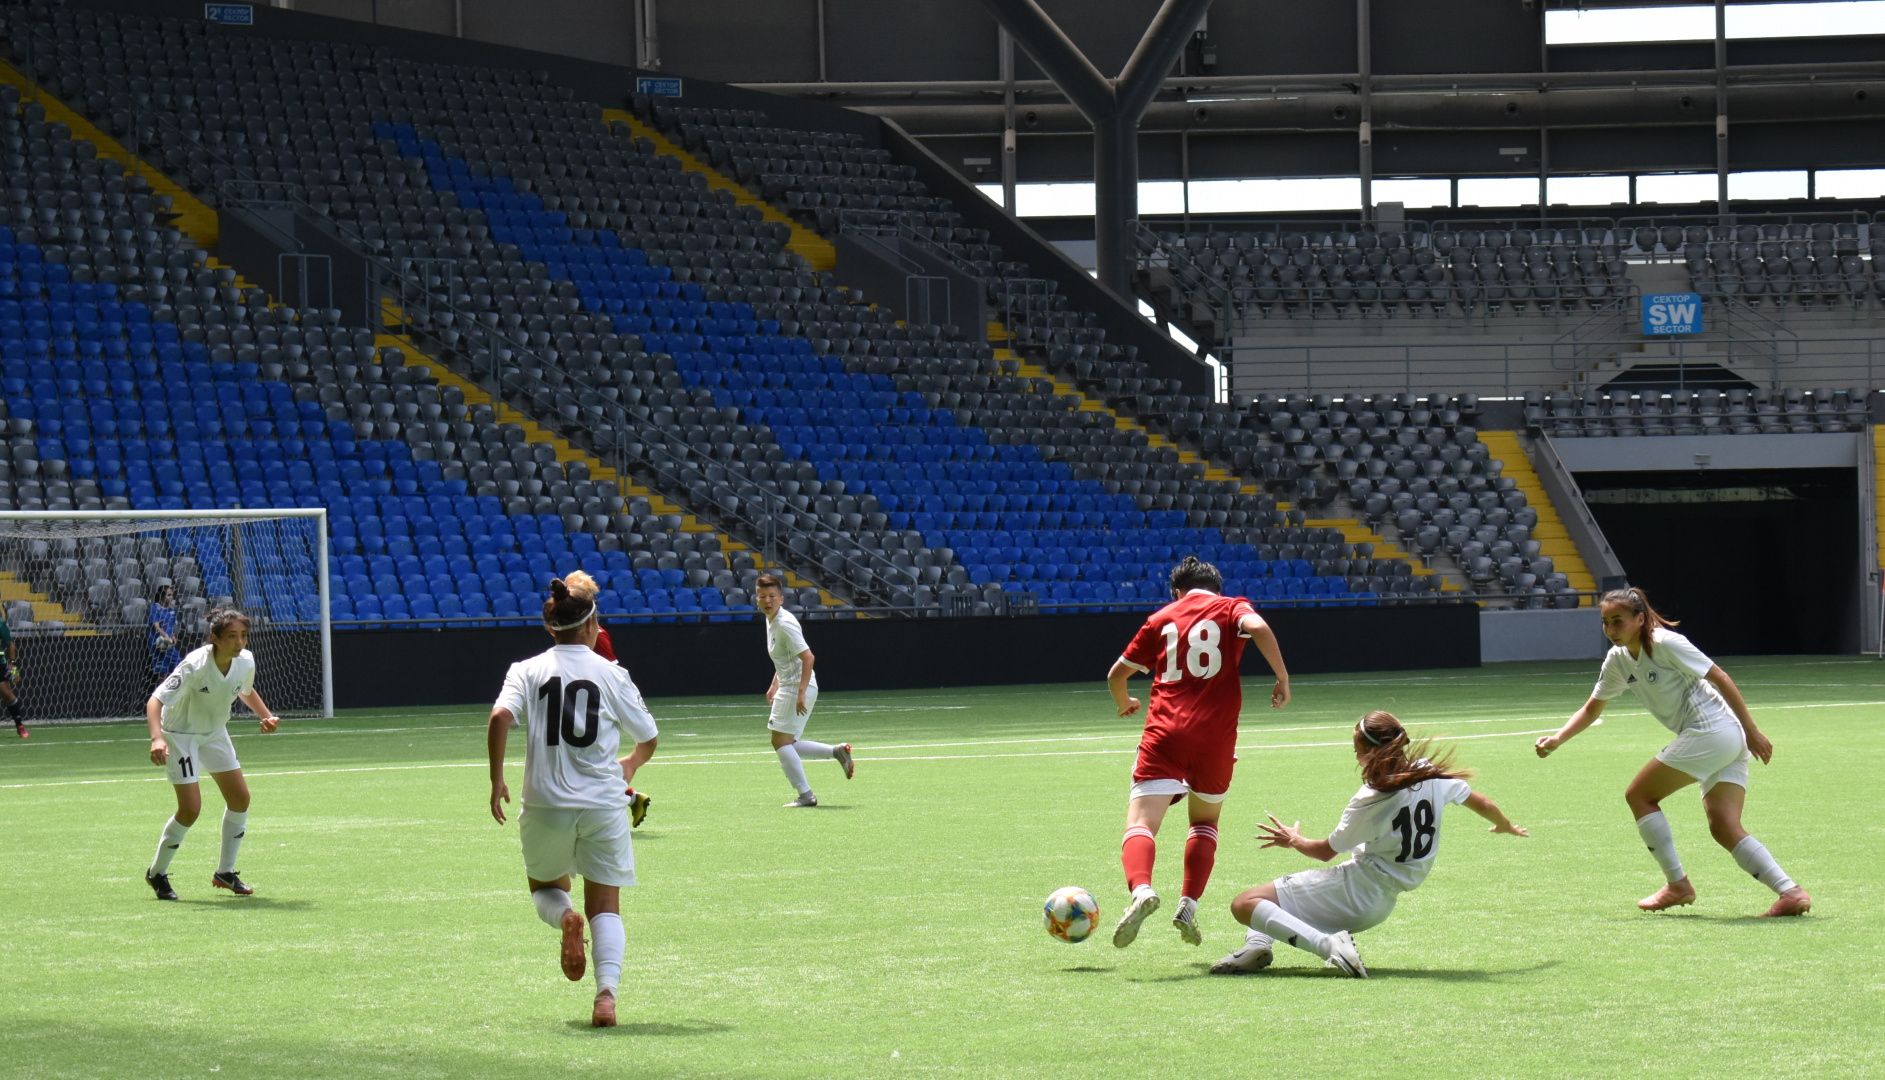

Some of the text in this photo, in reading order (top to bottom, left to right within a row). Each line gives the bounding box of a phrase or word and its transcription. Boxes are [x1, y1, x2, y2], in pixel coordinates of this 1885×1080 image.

[1652, 295, 1690, 304] СЕКТОР
[1649, 304, 1696, 325] SW
[1653, 325, 1691, 333] SECTOR
[1161, 619, 1222, 682] 18
[539, 676, 600, 748] 10
[178, 756, 194, 778] 11
[1392, 799, 1436, 862] 18
